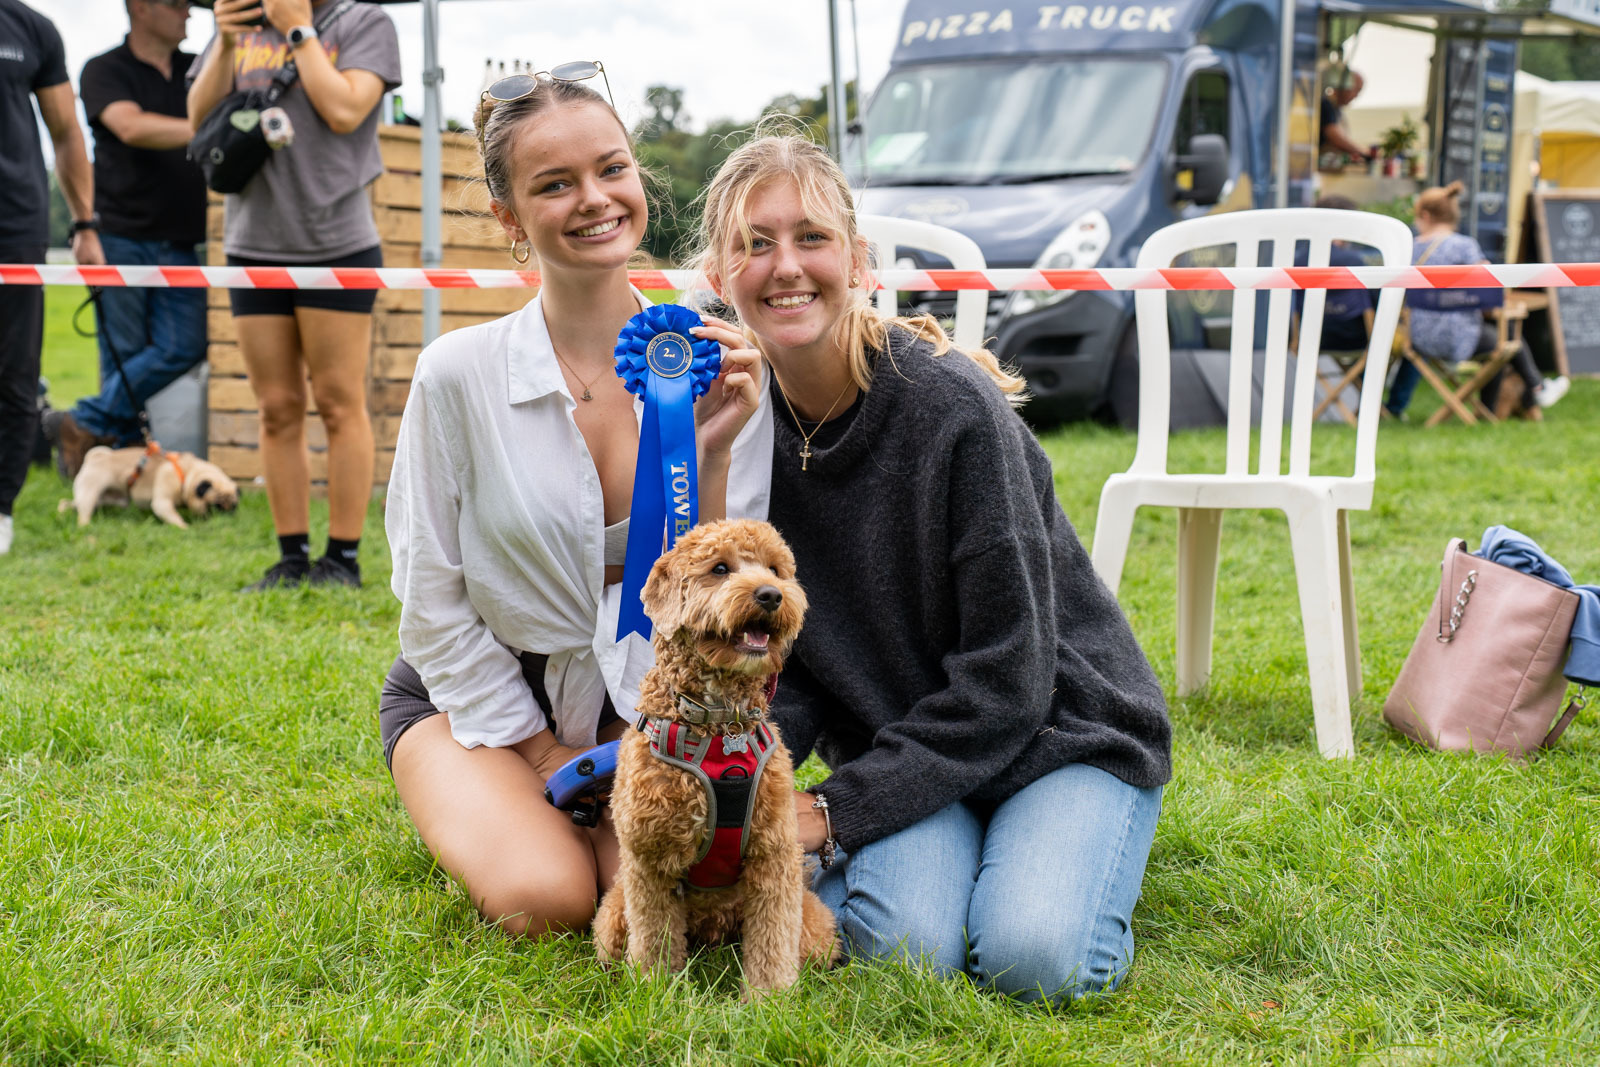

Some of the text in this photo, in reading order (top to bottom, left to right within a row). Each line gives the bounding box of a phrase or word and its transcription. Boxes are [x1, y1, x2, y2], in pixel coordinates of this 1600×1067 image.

[902, 6, 1177, 46] PIZZA TRUCK
[670, 461, 690, 540] TOWE
